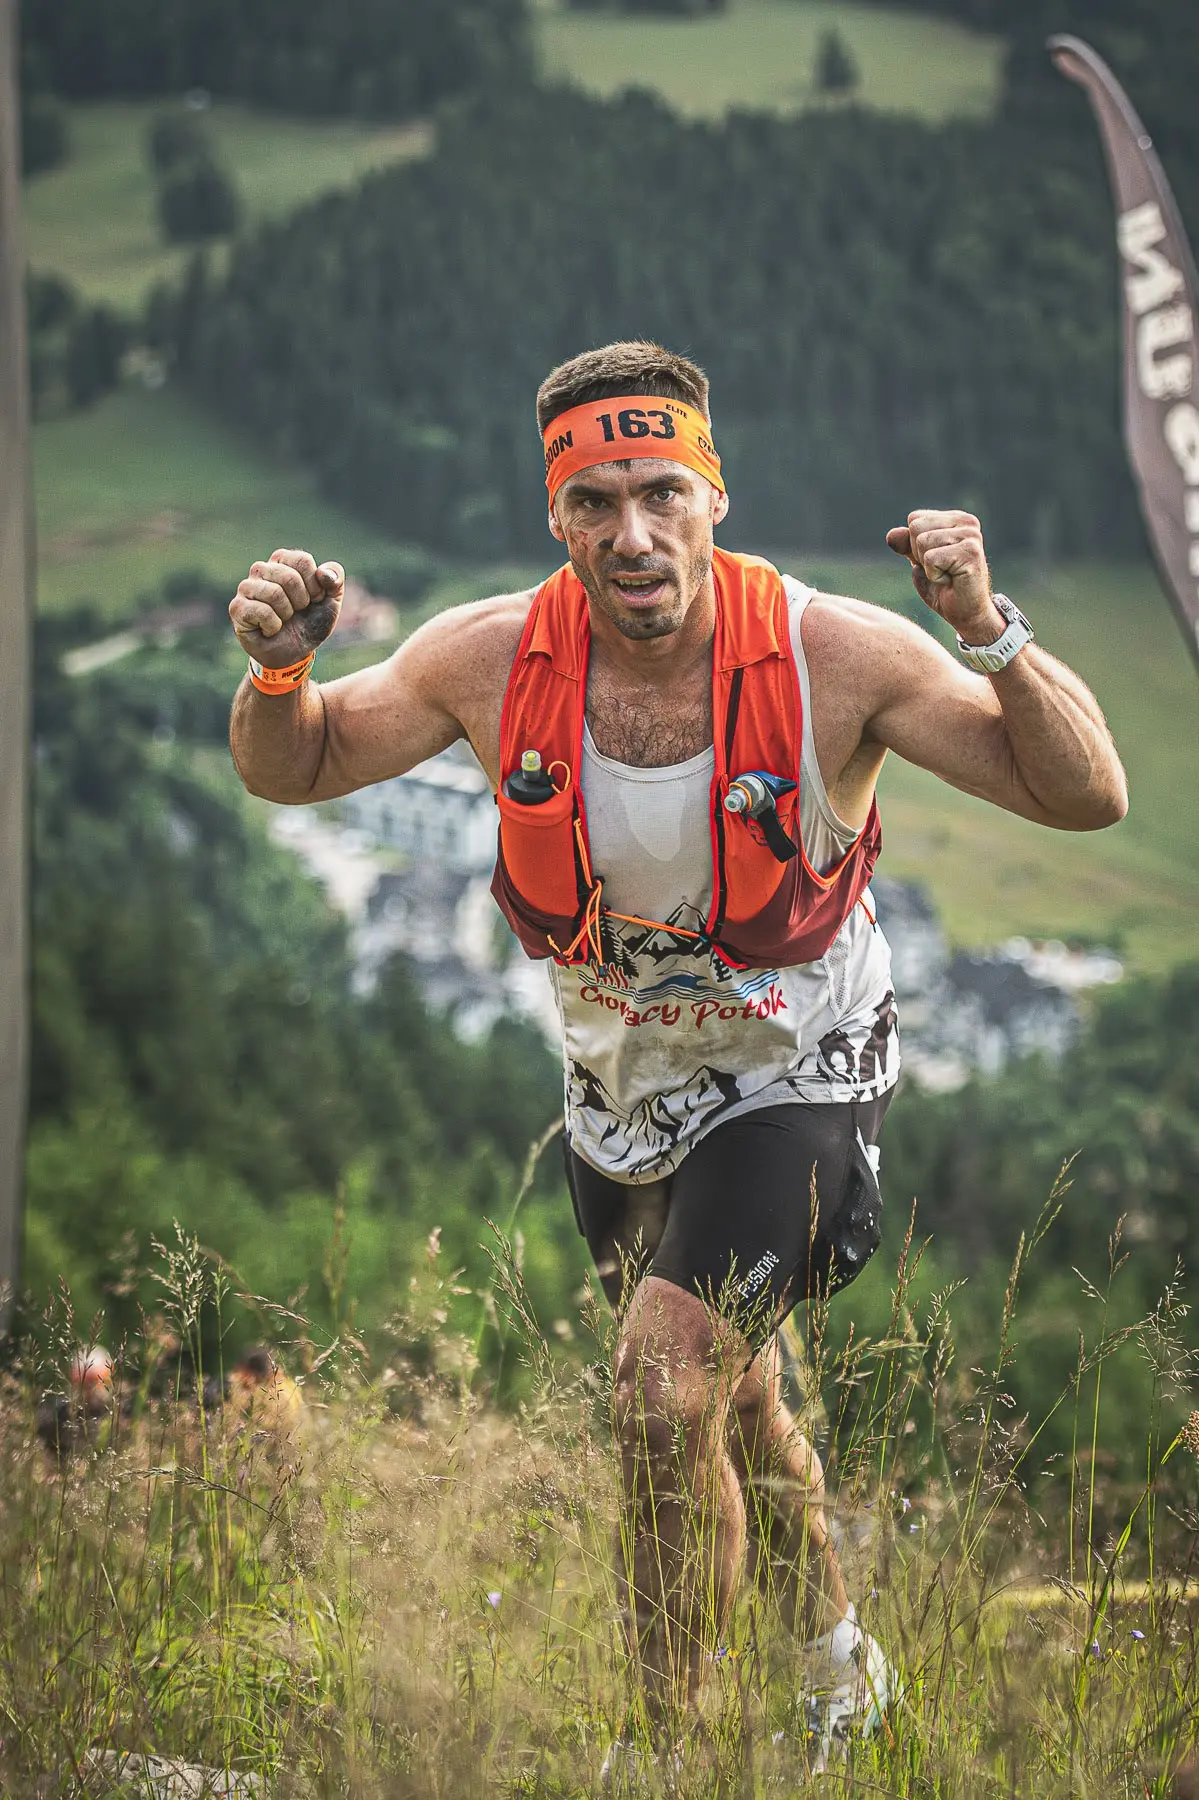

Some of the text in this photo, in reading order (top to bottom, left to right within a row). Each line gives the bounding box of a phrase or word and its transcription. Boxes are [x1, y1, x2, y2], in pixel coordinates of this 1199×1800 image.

[596, 409, 676, 442] 163
[666, 403, 688, 420] ELITE
[690, 982, 788, 1030] Potok
[737, 1250, 780, 1299] FUSION
